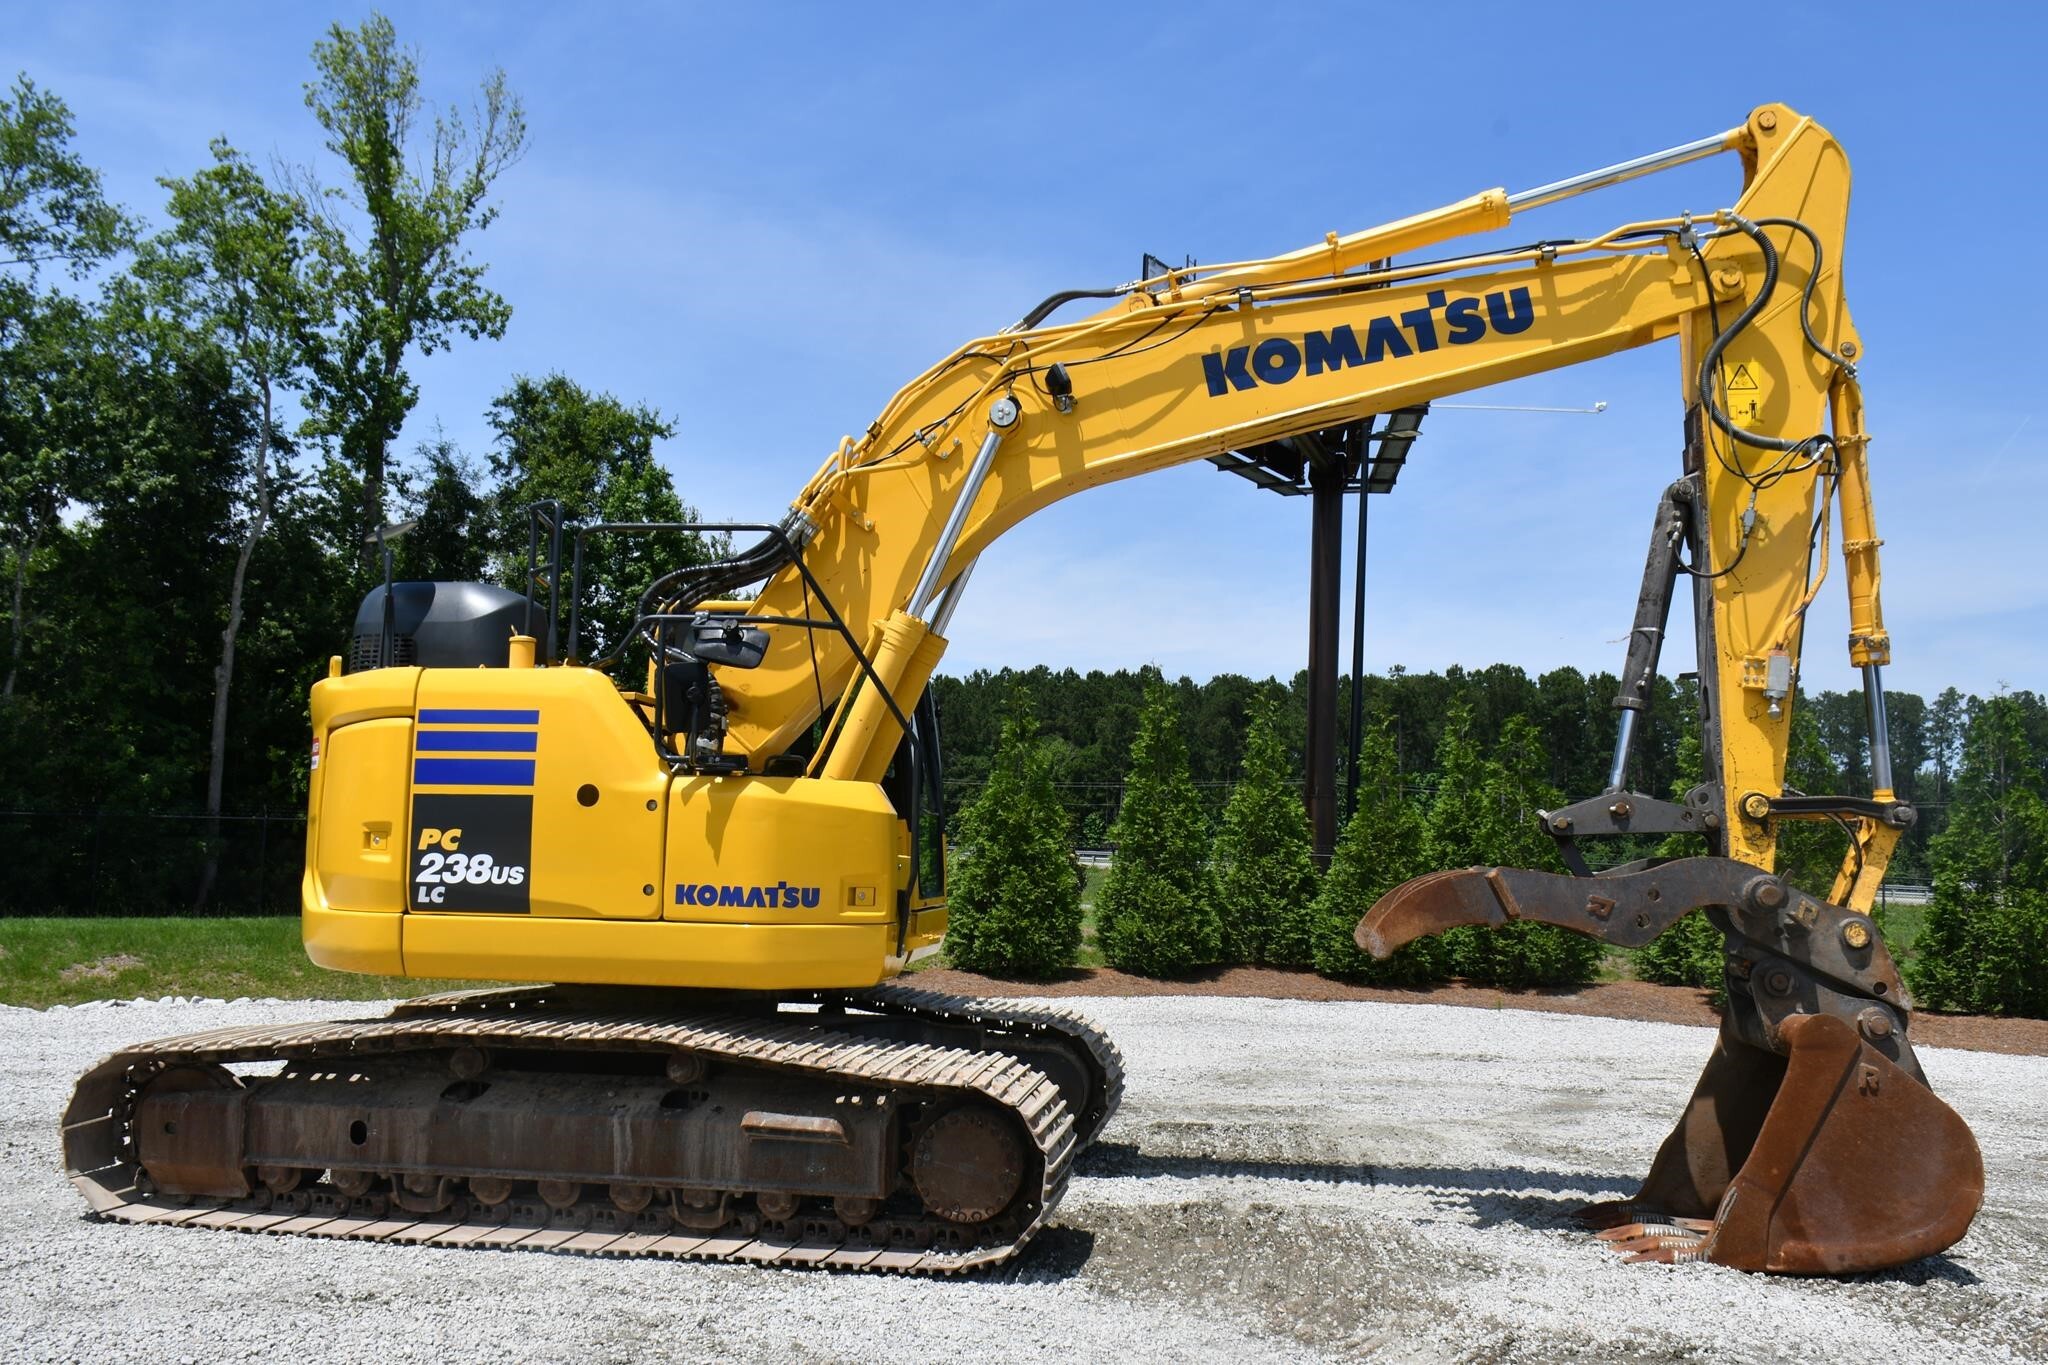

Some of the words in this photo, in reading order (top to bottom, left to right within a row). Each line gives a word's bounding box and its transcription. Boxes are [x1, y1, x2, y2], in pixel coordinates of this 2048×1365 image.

[1201, 286, 1534, 397] KOMATSU
[417, 828, 462, 851] PC
[417, 886, 446, 904] LC
[675, 881, 821, 908] KOMATSU
